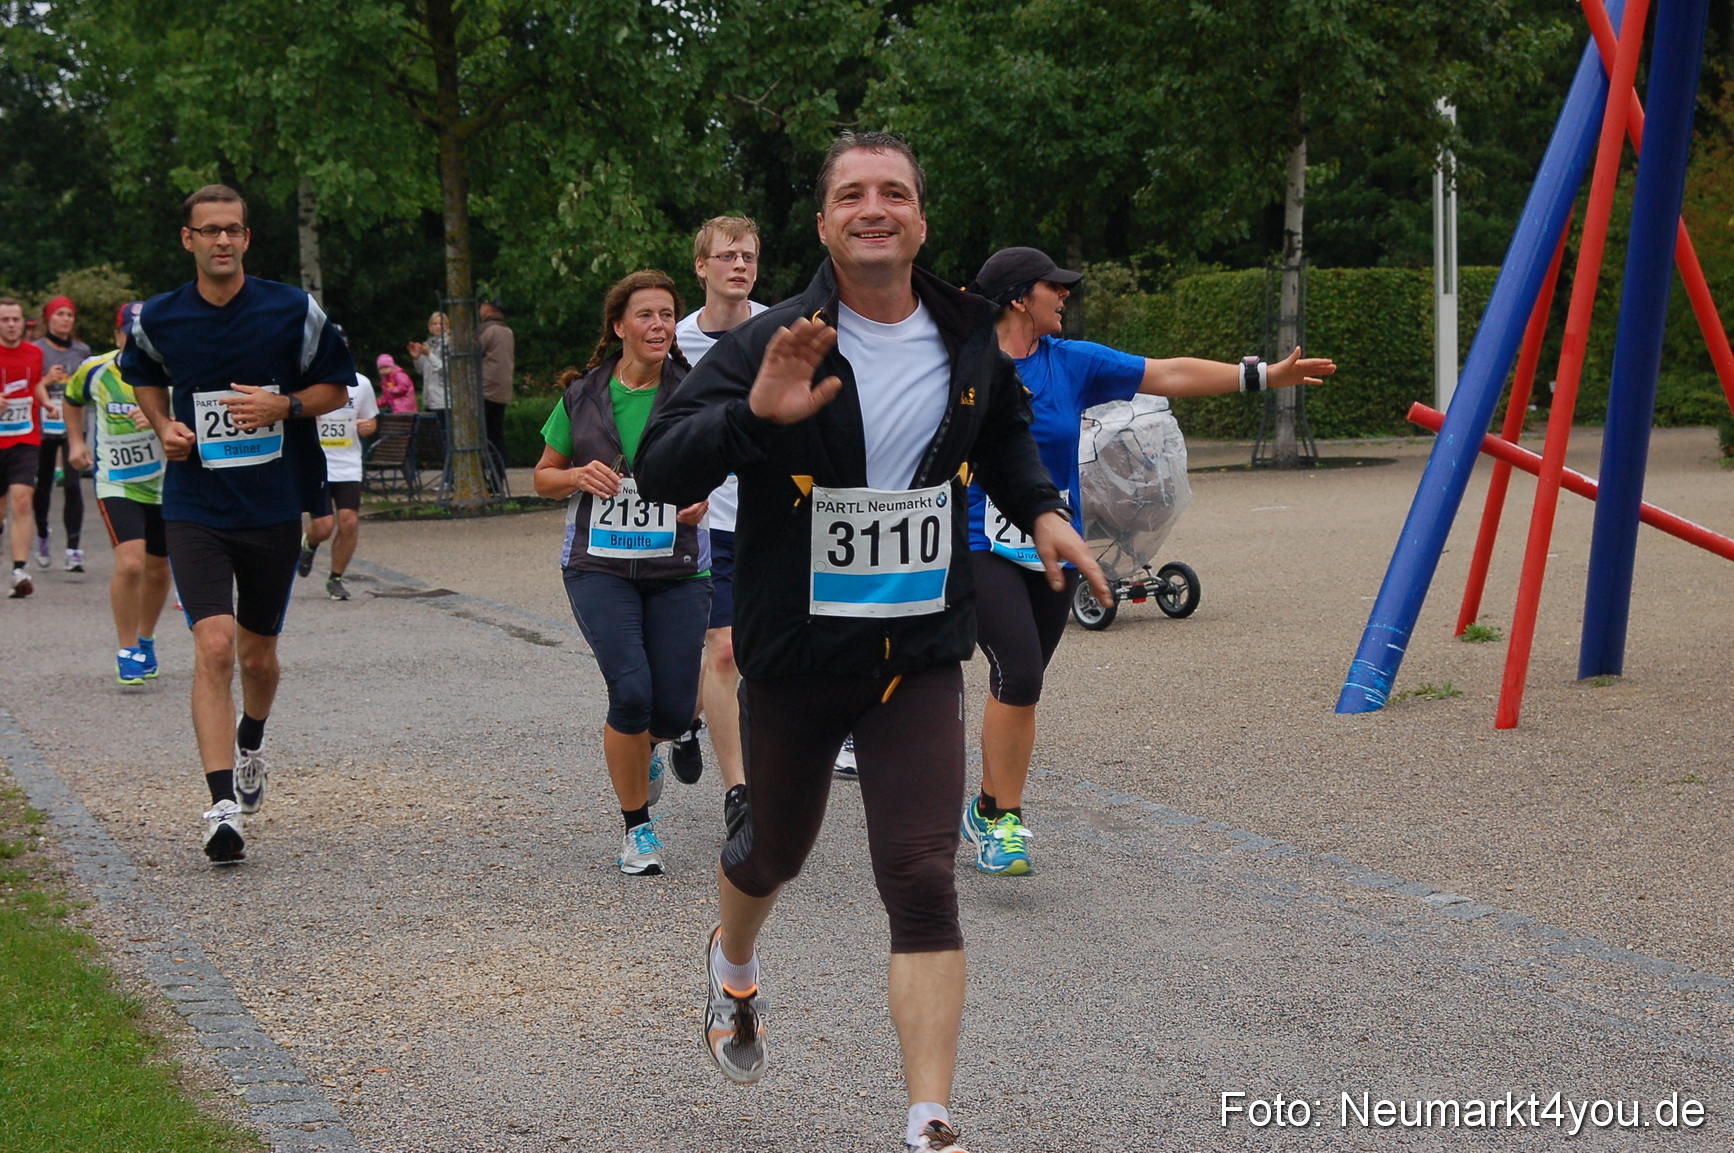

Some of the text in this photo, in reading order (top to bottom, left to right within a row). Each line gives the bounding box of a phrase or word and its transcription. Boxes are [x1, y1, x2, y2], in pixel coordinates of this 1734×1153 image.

[321, 423, 346, 437] 253
[110, 443, 154, 466] 3051
[224, 444, 261, 456] Rainer
[599, 498, 664, 527] 2131
[816, 497, 932, 513] PARTL Neumarkt
[610, 534, 652, 549] Brigitte
[827, 515, 941, 567] 3110
